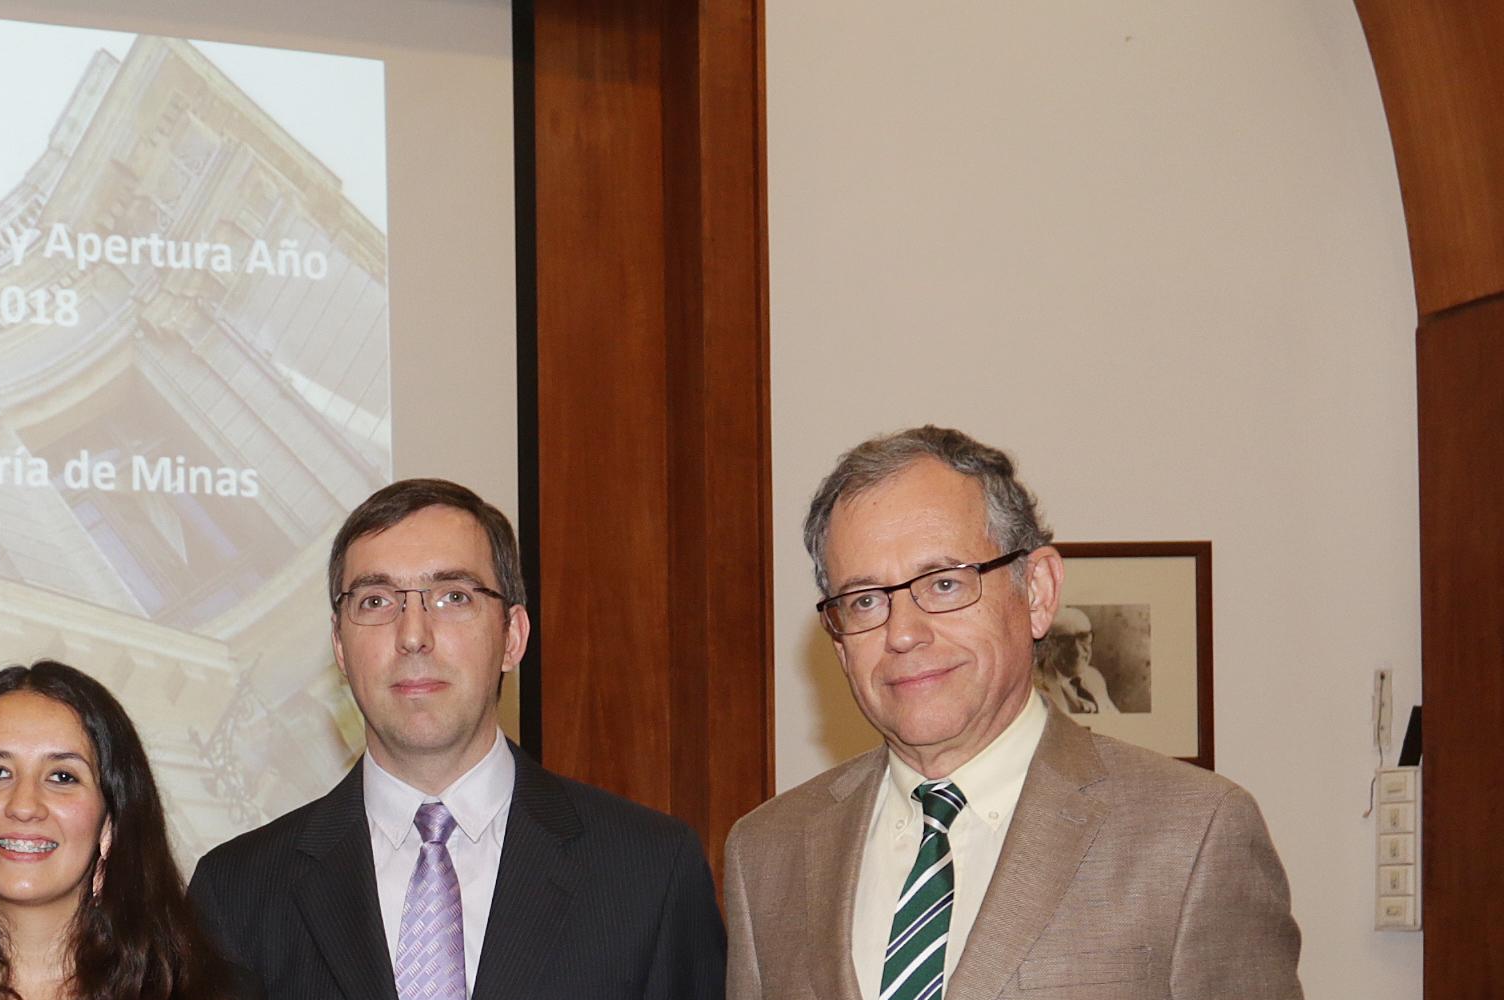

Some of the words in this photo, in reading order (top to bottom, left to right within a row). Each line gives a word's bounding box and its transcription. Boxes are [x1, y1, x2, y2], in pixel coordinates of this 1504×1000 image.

[3, 230, 36, 266] y
[45, 223, 232, 273] Apertura
[246, 236, 329, 280] Año
[64, 450, 116, 490] de
[132, 455, 259, 499] Minas
